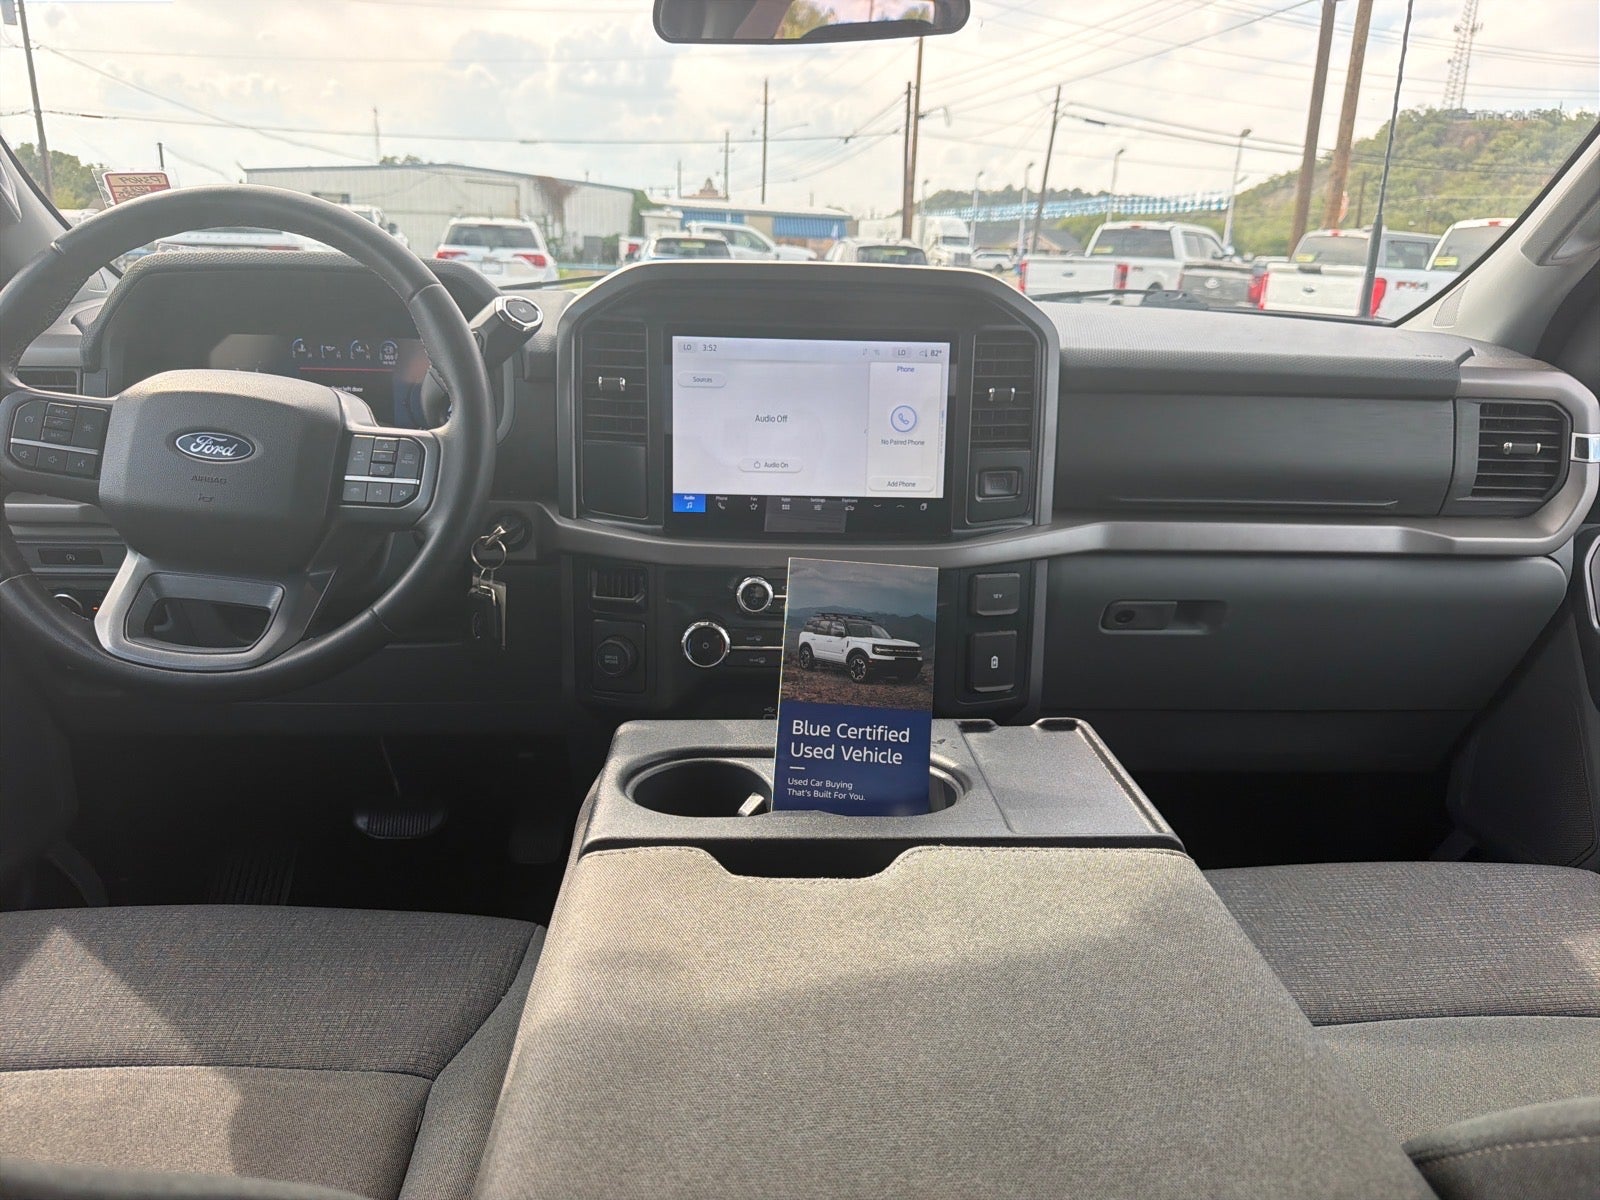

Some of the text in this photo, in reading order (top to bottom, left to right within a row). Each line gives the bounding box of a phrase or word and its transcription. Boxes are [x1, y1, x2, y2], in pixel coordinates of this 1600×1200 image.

[683, 343, 692, 351] LO
[703, 343, 717, 352] 3:52
[896, 365, 915, 373] Phone
[755, 414, 788, 423] Audio Off
[189, 434, 238, 456] Ford
[764, 461, 789, 469] Audio On
[887, 480, 917, 488] Add Phone
[791, 719, 910, 743] Blue Certified
[790, 742, 903, 765] Used Vehicle
[787, 777, 853, 791] Used Car Buying
[786, 788, 866, 801] That's Built For You.
